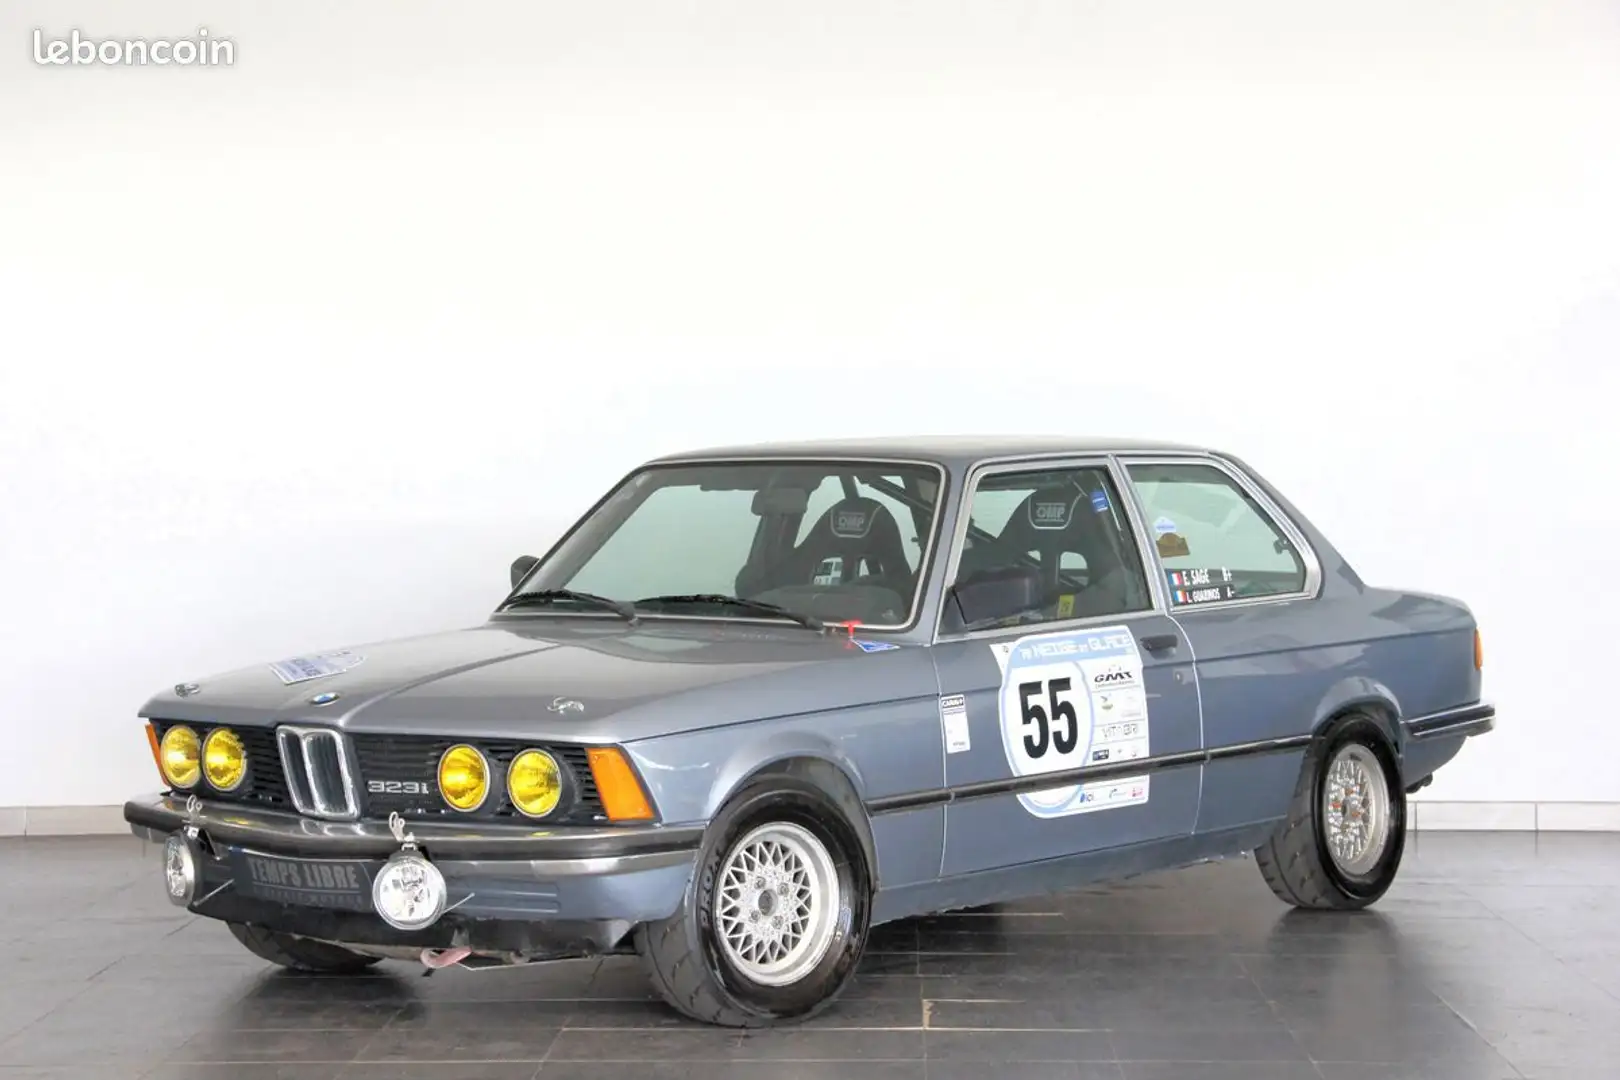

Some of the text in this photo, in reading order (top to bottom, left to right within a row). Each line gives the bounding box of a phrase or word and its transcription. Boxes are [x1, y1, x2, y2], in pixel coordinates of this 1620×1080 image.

[1191, 568, 1210, 585] SAGE
[1018, 677, 1078, 759] 55
[368, 780, 429, 794] 323i
[247, 857, 360, 888] TEMPS LIBRE
